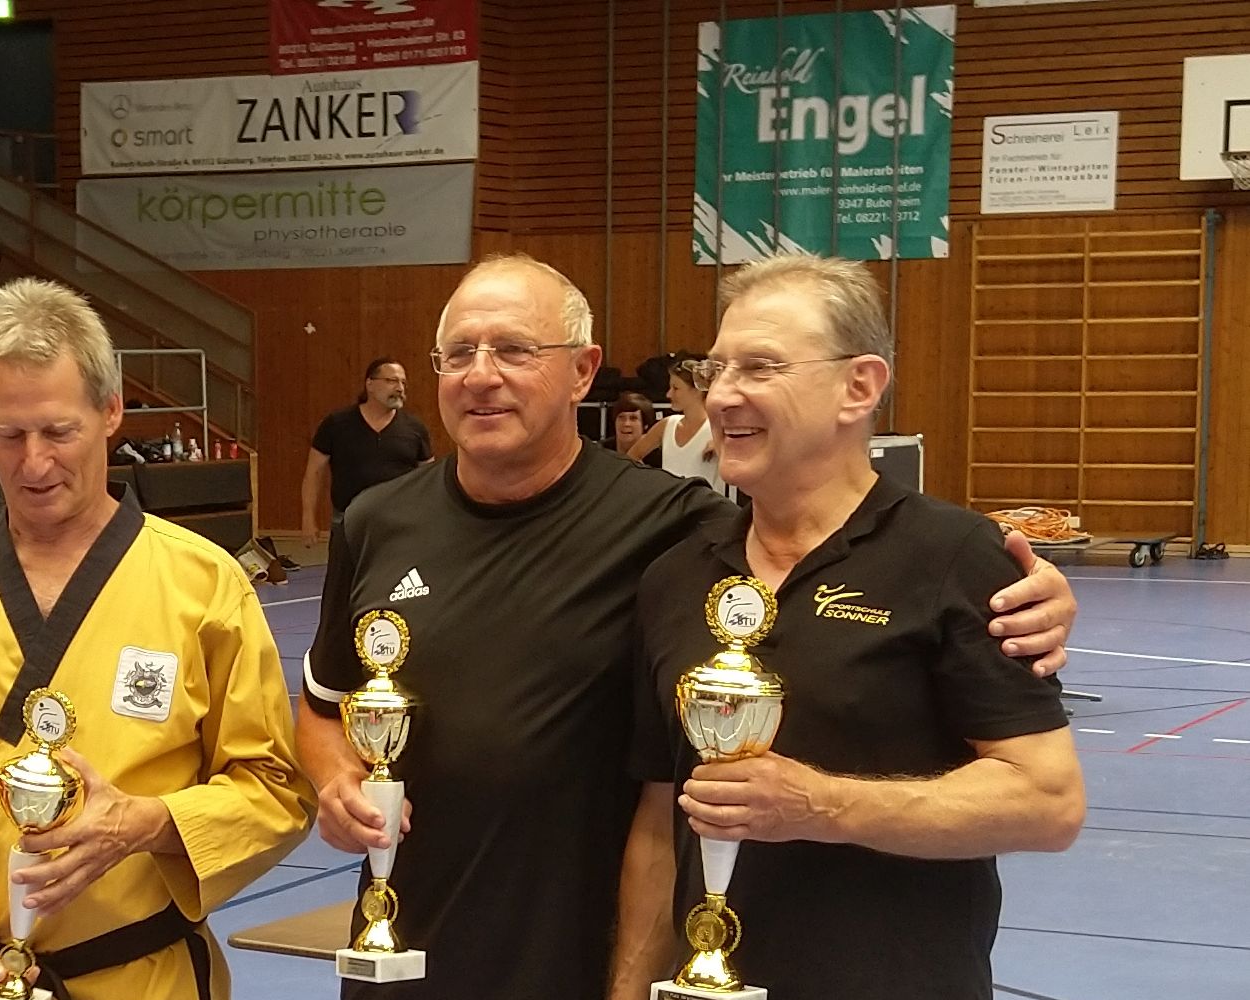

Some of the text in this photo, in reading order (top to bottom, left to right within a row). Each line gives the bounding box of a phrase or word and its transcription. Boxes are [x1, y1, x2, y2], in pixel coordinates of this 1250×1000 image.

[303, 79, 363, 93] Autohaus
[237, 91, 418, 143] ZANKER
[758, 75, 926, 155] Engel
[134, 126, 194, 146] smart
[1073, 125, 1110, 136] Leix
[137, 182, 386, 228] körpermitte
[253, 223, 407, 242] physiotherapie
[389, 586, 430, 602] adidas
[822, 609, 891, 626] SONNER
